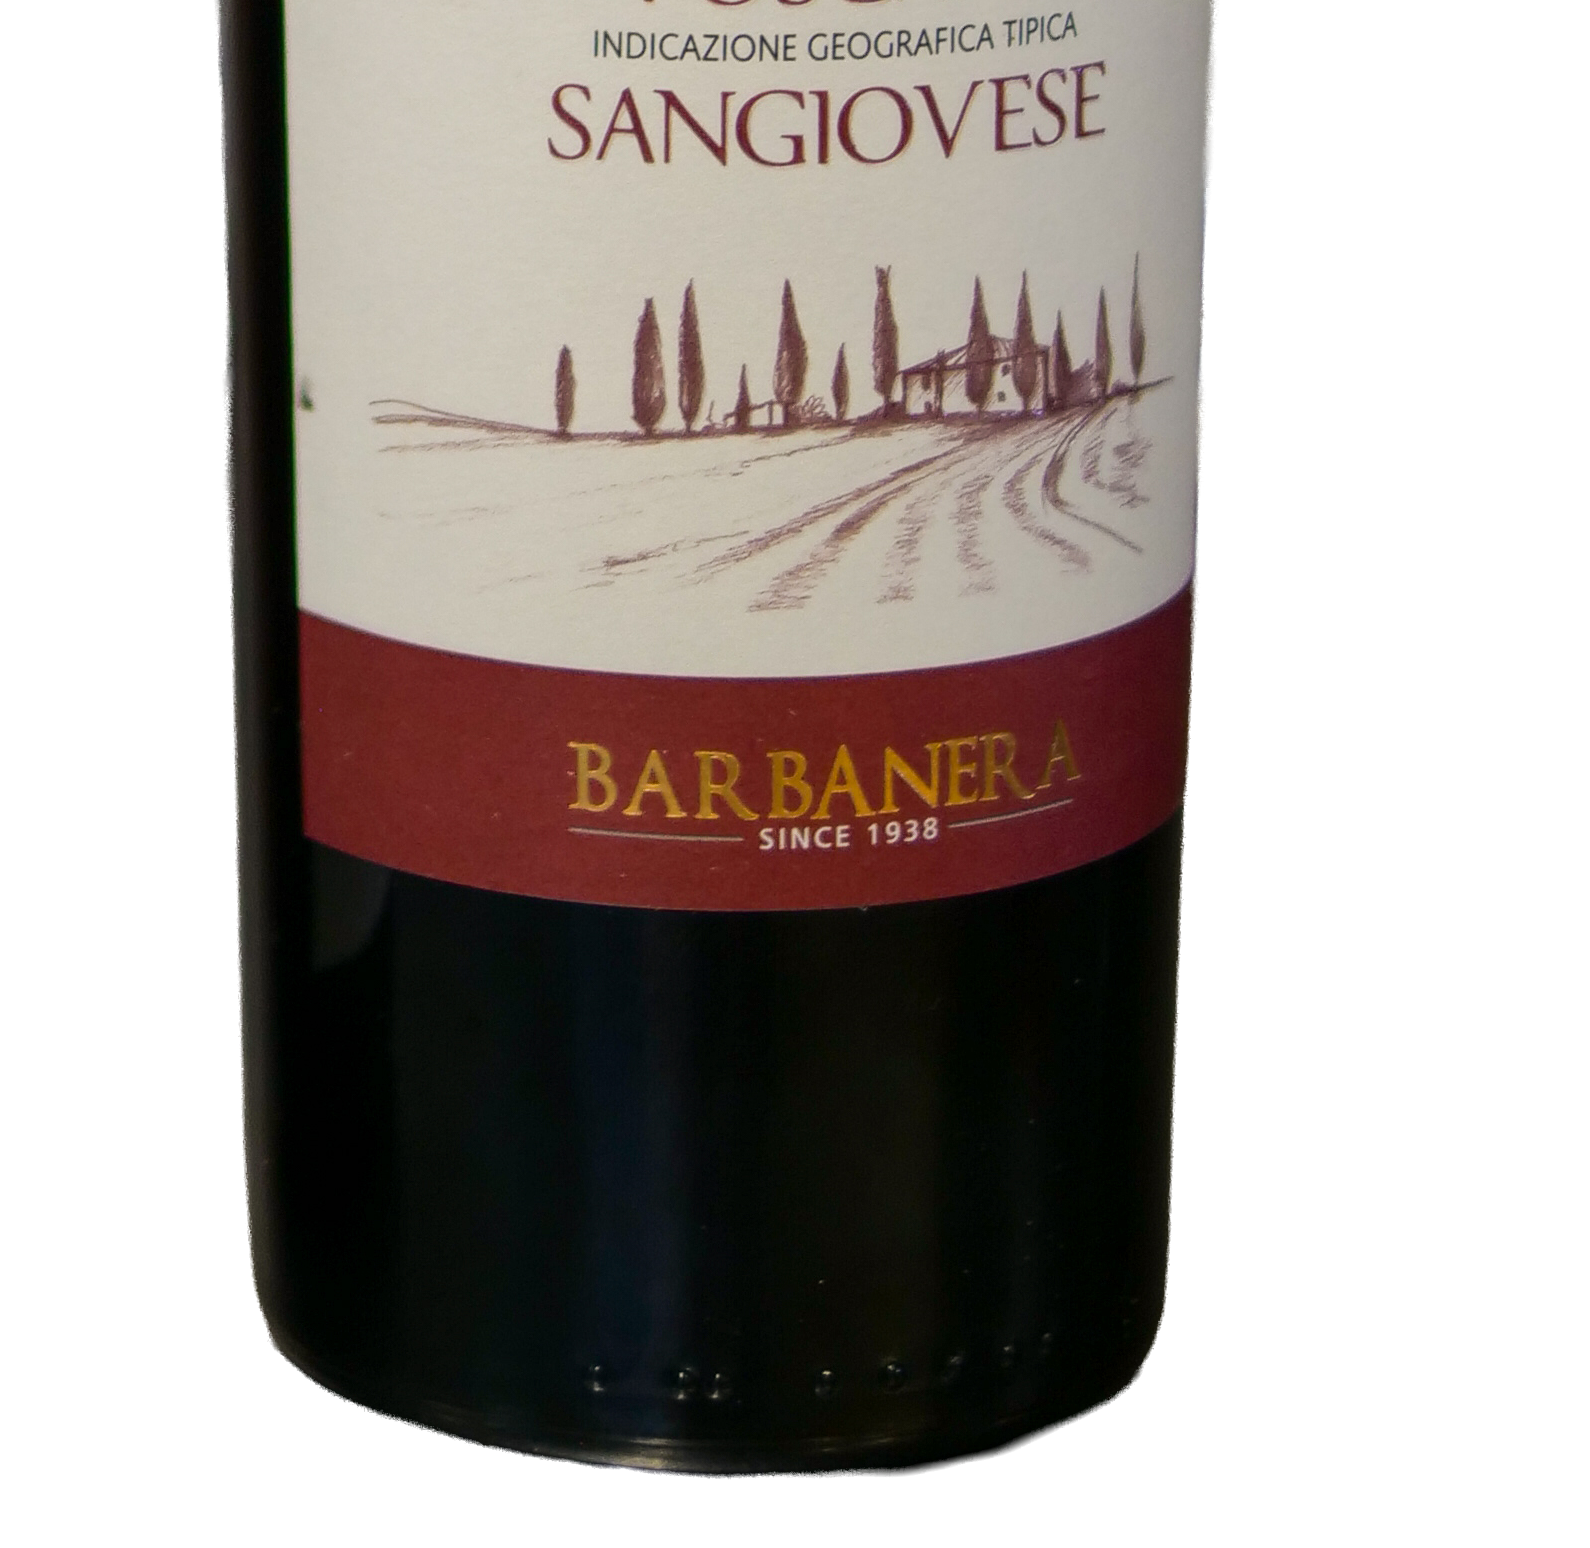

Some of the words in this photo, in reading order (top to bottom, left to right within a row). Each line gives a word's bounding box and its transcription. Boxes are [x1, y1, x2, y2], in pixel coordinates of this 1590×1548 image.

[592, 28, 797, 62] INDICAZIONE
[807, 22, 994, 61] GEOGRAFICA
[1002, 10, 1078, 48] TIPICA
[547, 59, 1107, 167] SANGIOVESE
[566, 719, 1082, 821] BARBANERA
[759, 824, 851, 850] SINCE
[868, 817, 939, 845] 1938
